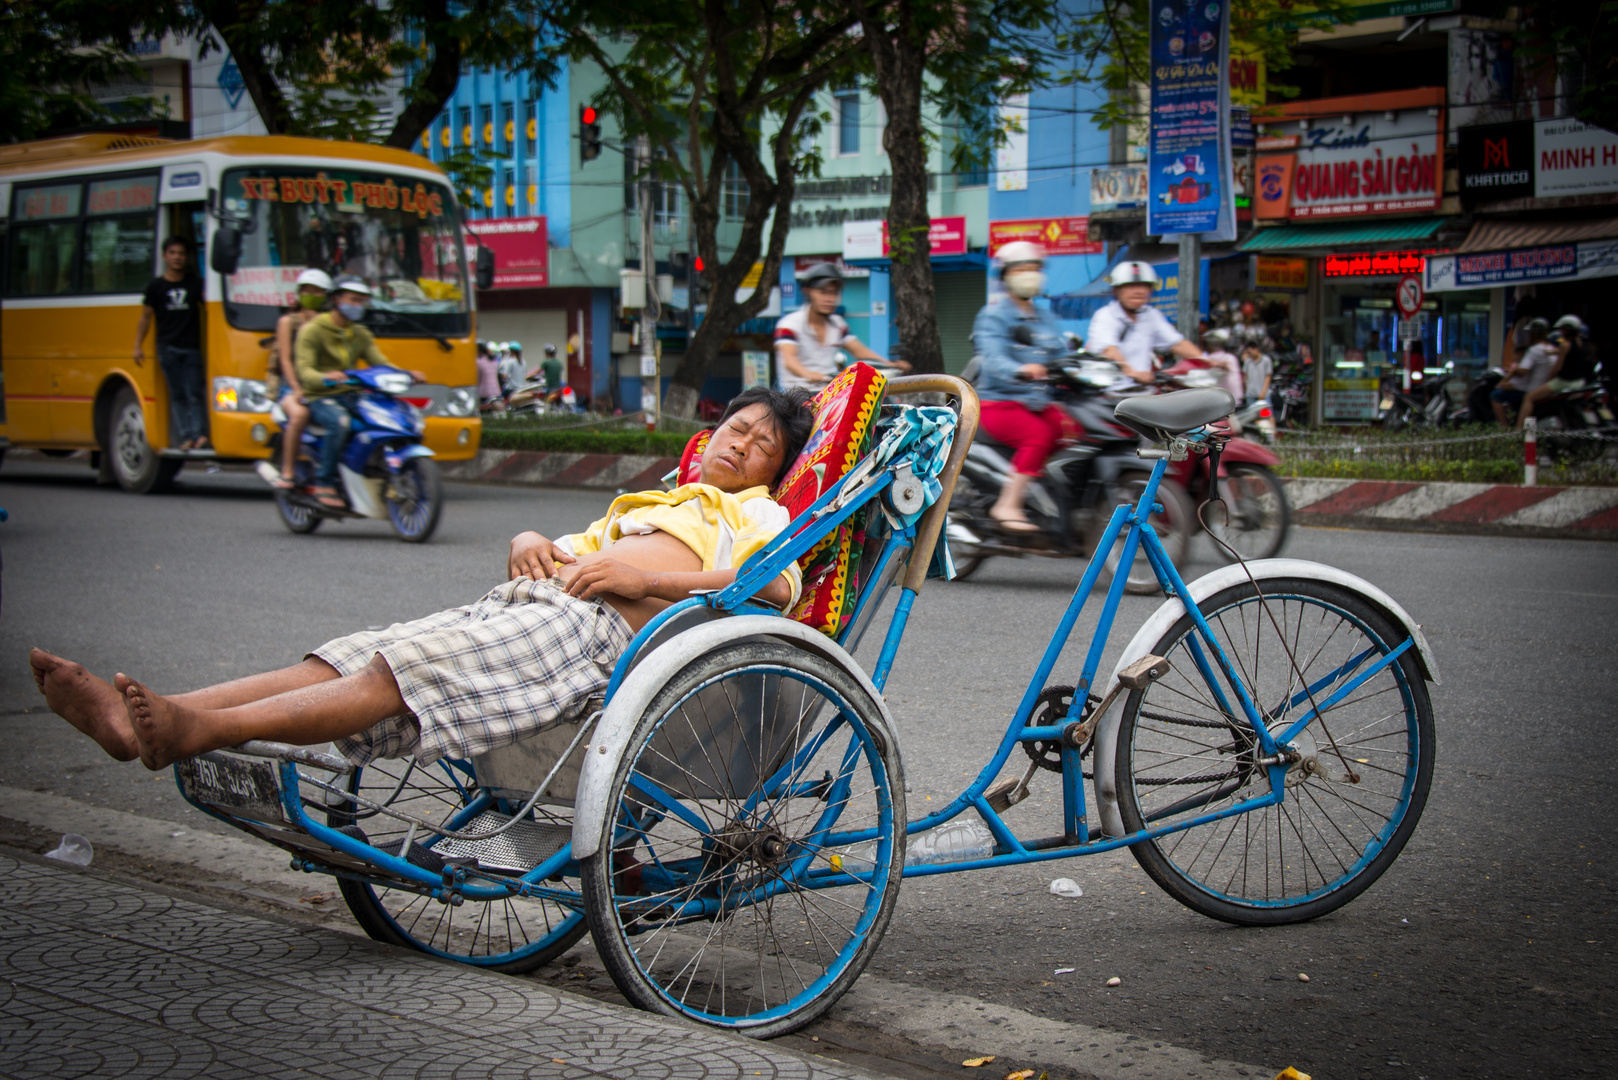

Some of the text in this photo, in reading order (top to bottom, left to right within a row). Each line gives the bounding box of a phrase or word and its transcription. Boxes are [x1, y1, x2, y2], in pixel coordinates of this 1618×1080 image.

[1295, 159, 1359, 202] QUANG
[1361, 148, 1393, 196] SÀI
[1394, 142, 1437, 195] GÒN
[1540, 145, 1595, 172] MINH
[1465, 170, 1530, 188] KHATOCO
[239, 172, 444, 219] XE BUÝT PHÚ LỘC
[1432, 262, 1454, 284] SHOP
[1458, 253, 1506, 273] MINH
[1510, 246, 1575, 268] HƯƠNG
